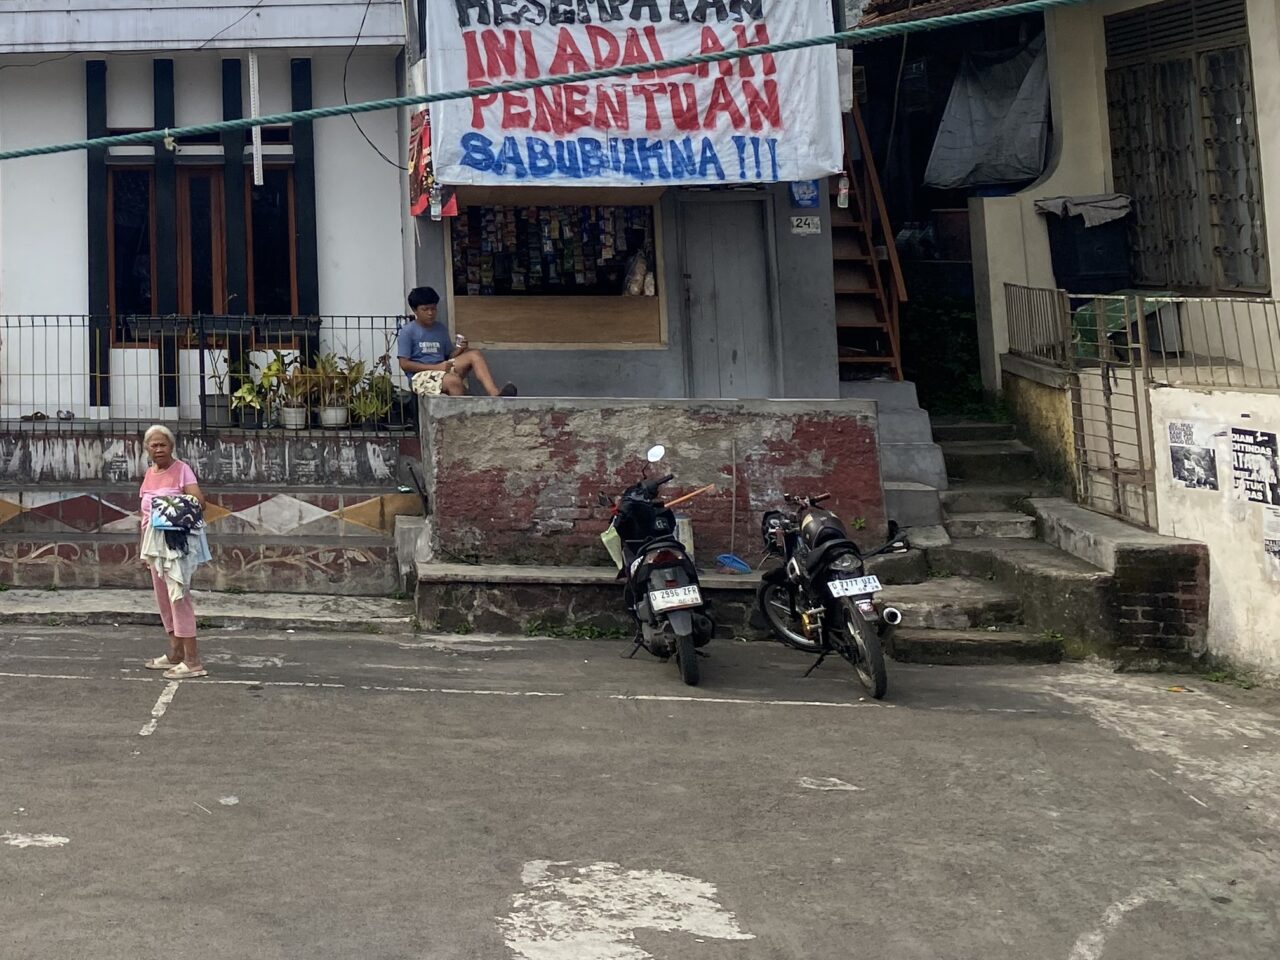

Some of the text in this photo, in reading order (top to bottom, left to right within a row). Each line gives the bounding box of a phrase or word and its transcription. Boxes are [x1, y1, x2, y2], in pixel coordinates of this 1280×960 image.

[463, 23, 777, 82] INI ADALAH
[468, 78, 783, 135] PENENTUAN
[795, 217, 811, 229] 24
[1232, 433, 1254, 443] DIAM
[1232, 443, 1272, 455] DITINDAS
[838, 579, 858, 589] 7777
[650, 586, 698, 602] D 2996 ZFR
